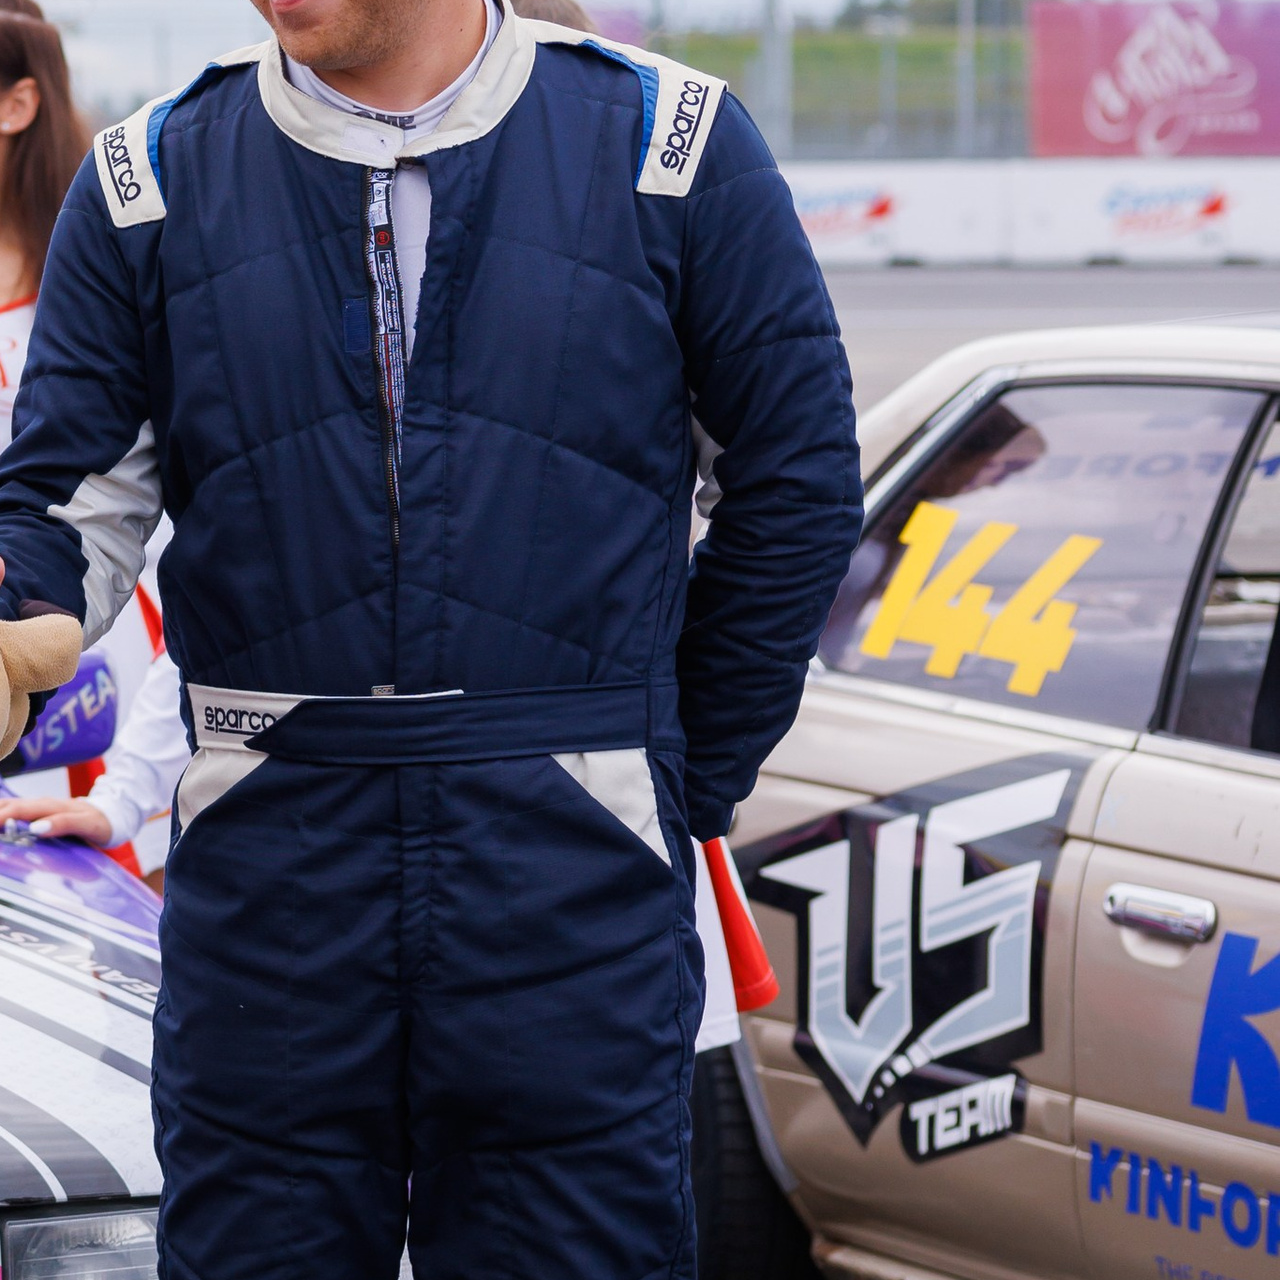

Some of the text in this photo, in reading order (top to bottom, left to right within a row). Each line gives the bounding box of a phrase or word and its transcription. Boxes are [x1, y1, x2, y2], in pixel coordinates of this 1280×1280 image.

[102, 126, 142, 202] sparco
[660, 80, 704, 170] sparco
[859, 500, 1104, 698] 144
[204, 705, 277, 733] sparco
[909, 1072, 1017, 1155] TEAM
